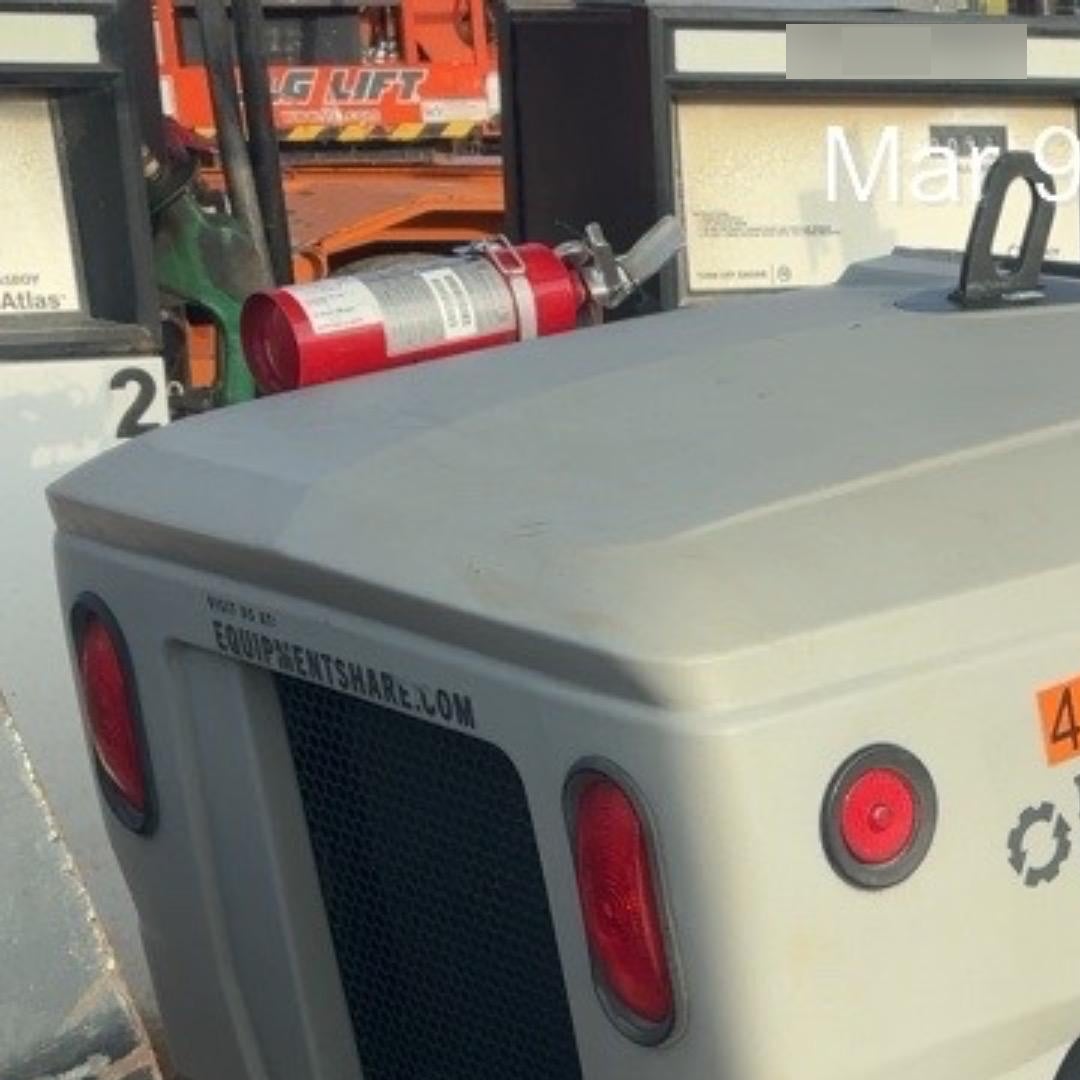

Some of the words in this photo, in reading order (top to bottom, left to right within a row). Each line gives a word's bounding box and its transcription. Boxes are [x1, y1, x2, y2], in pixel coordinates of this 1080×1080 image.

[323, 67, 429, 106] LIFT
[110, 367, 160, 438] 2
[212, 619, 475, 729] EQUIPMENTSHARE.COM
